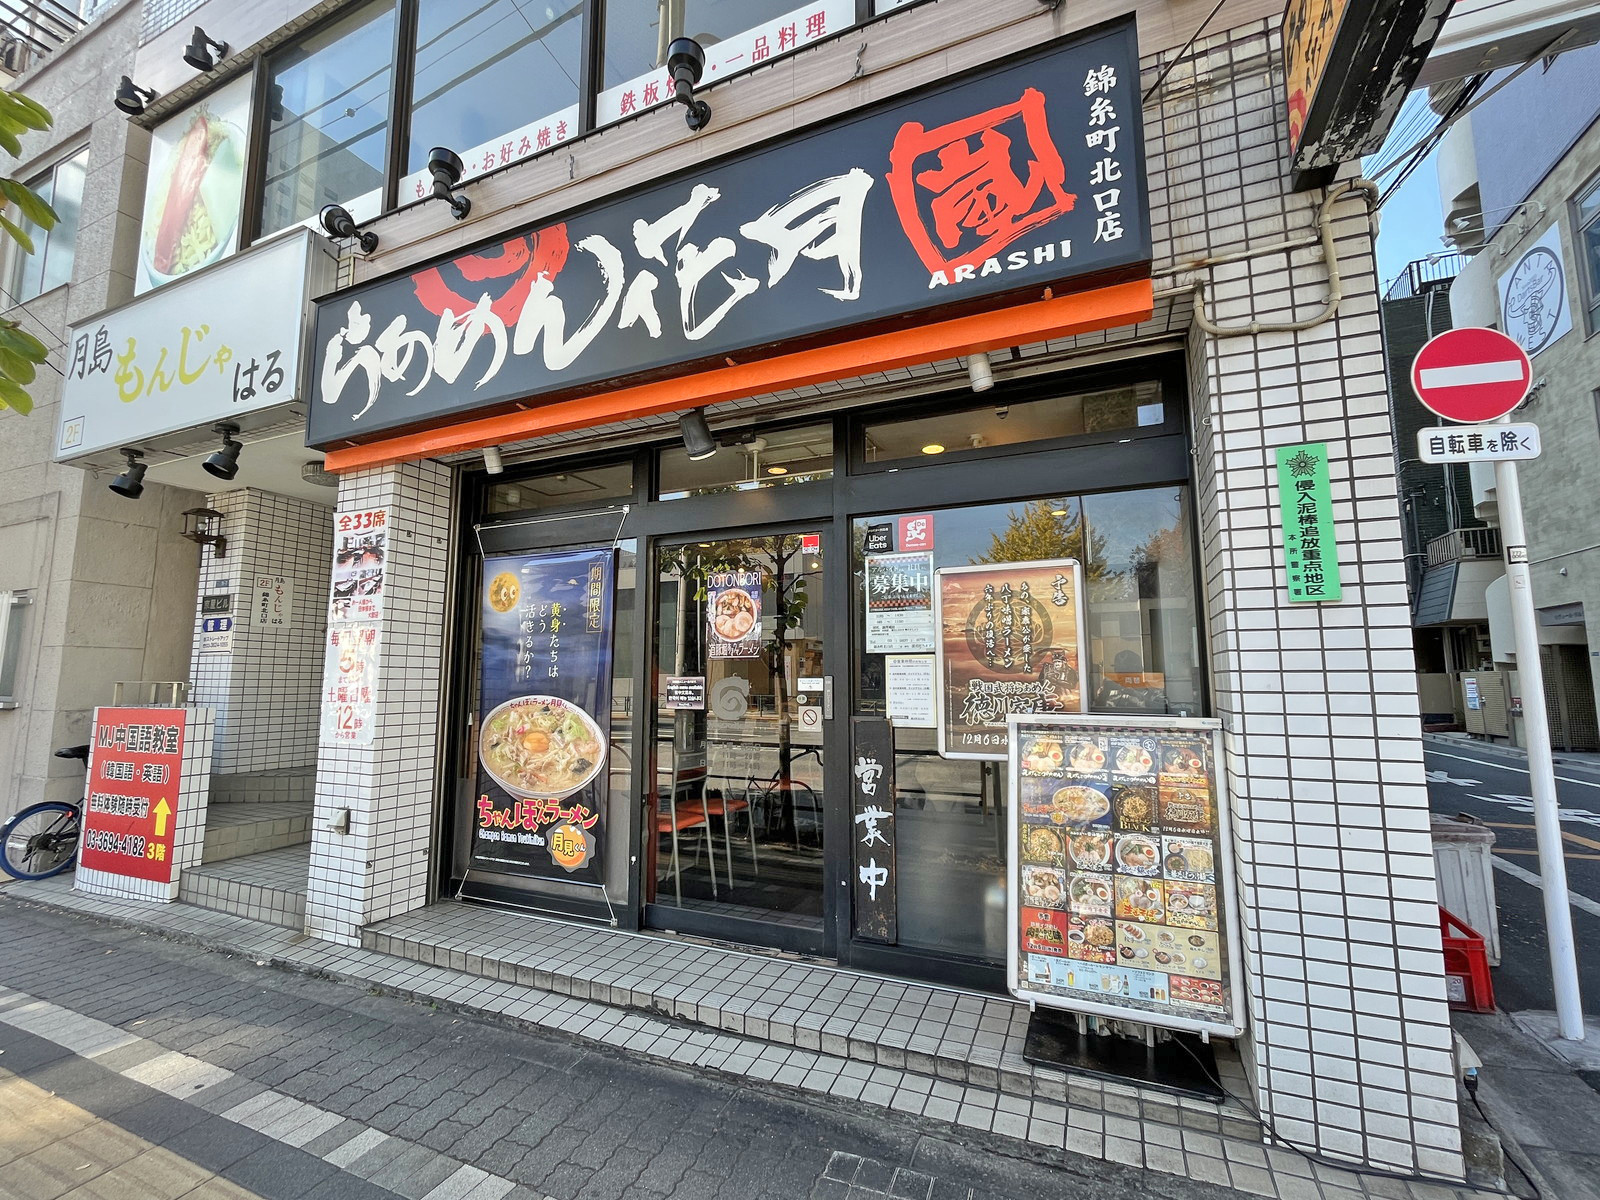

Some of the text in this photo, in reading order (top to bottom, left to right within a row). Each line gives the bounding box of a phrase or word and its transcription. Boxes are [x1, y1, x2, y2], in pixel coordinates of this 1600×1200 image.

[620, 10, 826, 115] 鉄板焼・一品料理
[1082, 64, 1125, 245] 錦糸町北口店
[928, 239, 1072, 290] ARASHI
[64, 423, 79, 445] 2F
[1429, 431, 1532, 455] 自転車を除く
[338, 510, 386, 532] 全33席
[869, 535, 887, 543] Uber
[869, 542, 888, 550] Eats
[1295, 480, 1326, 596] 侵入泥棒追放重点地区
[707, 571, 762, 589] DOTONBORI
[1288, 534, 1302, 596] 本所警察署
[588, 566, 602, 629] 期間限定
[871, 573, 929, 595] 募集中
[1051, 574, 1068, 607] 予告
[98, 723, 180, 755] MJ中国語教室
[477, 795, 599, 832] ちゃんぽんラーメン
[854, 756, 893, 901] 営業中
[86, 829, 166, 862] 03-3694-4182 3階
[552, 832, 587, 858] 月見くん
